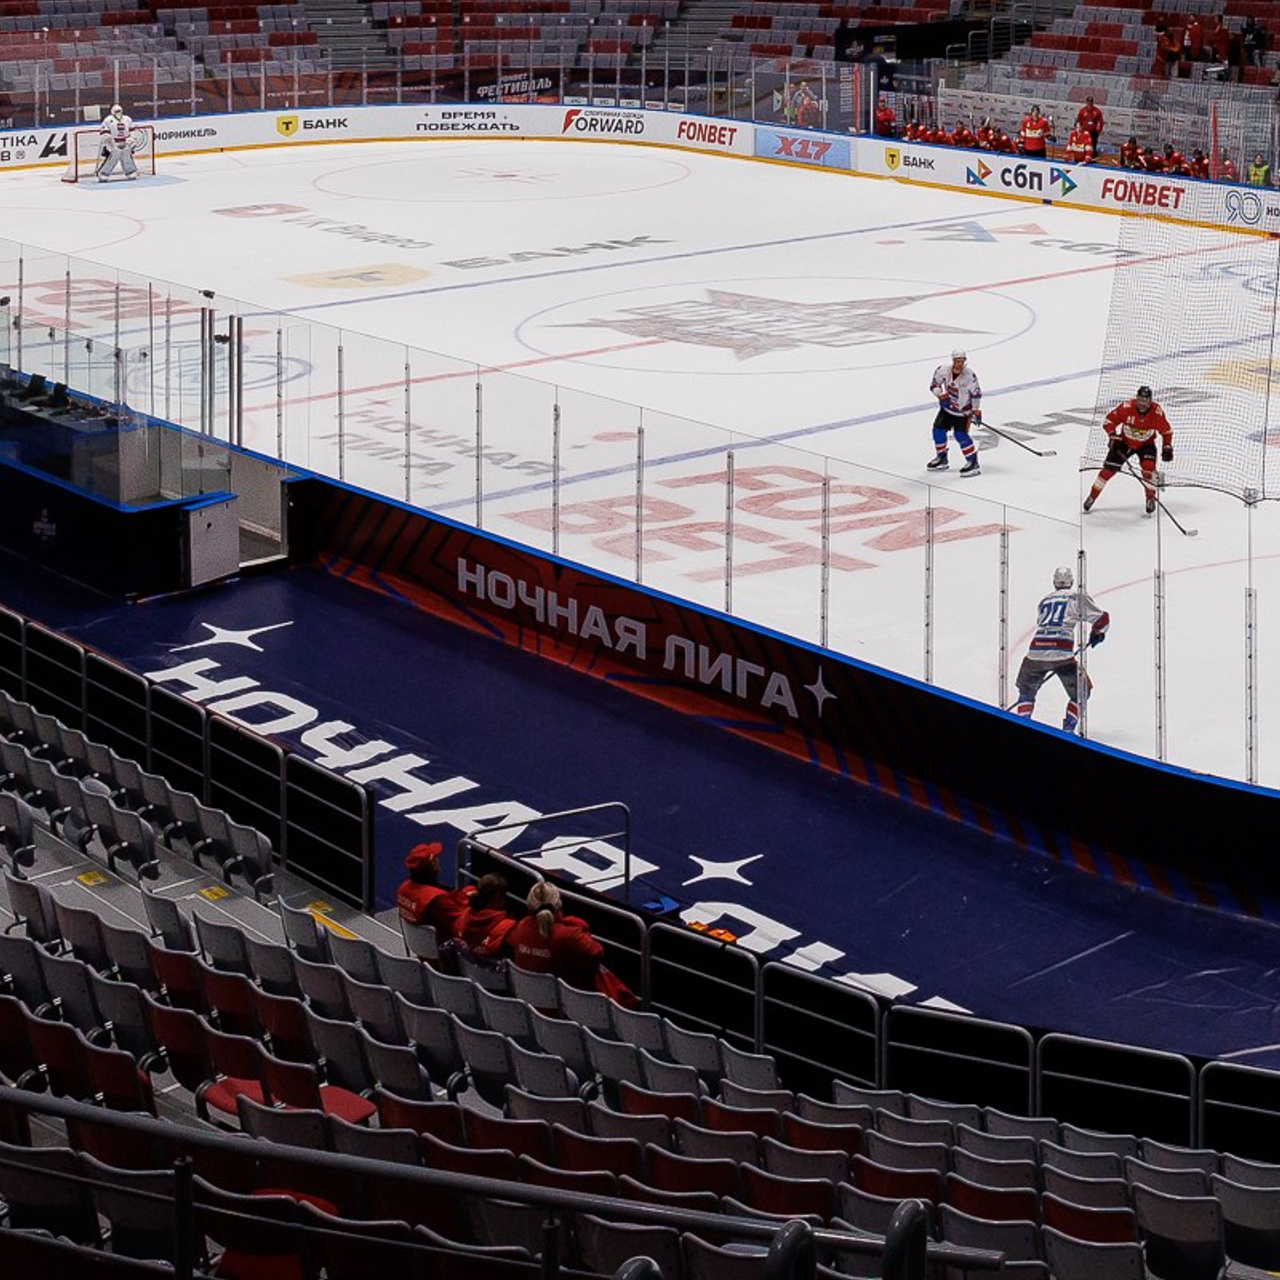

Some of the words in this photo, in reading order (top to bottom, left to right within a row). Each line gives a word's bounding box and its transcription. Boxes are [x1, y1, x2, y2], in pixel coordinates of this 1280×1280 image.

[303, 118, 349, 131] БАНК
[416, 122, 520, 132] ПОБЕЖДАТЬ
[441, 111, 497, 121] ВРЕМЯ
[562, 109, 645, 134] FORWARD
[152, 129, 218, 143] НОРНИКЕЛЬ
[677, 120, 738, 147] FONBET
[775, 135, 833, 161] X17
[903, 154, 936, 171] БАНК
[1001, 164, 1043, 192] сбп
[1101, 178, 1186, 210] FONBET
[656, 465, 1024, 552] FON
[500, 493, 879, 584] BET
[457, 557, 647, 661] НОЧНАЯ
[662, 634, 800, 719] ЛИГА
[143, 657, 660, 893] НОЧНАЯ
